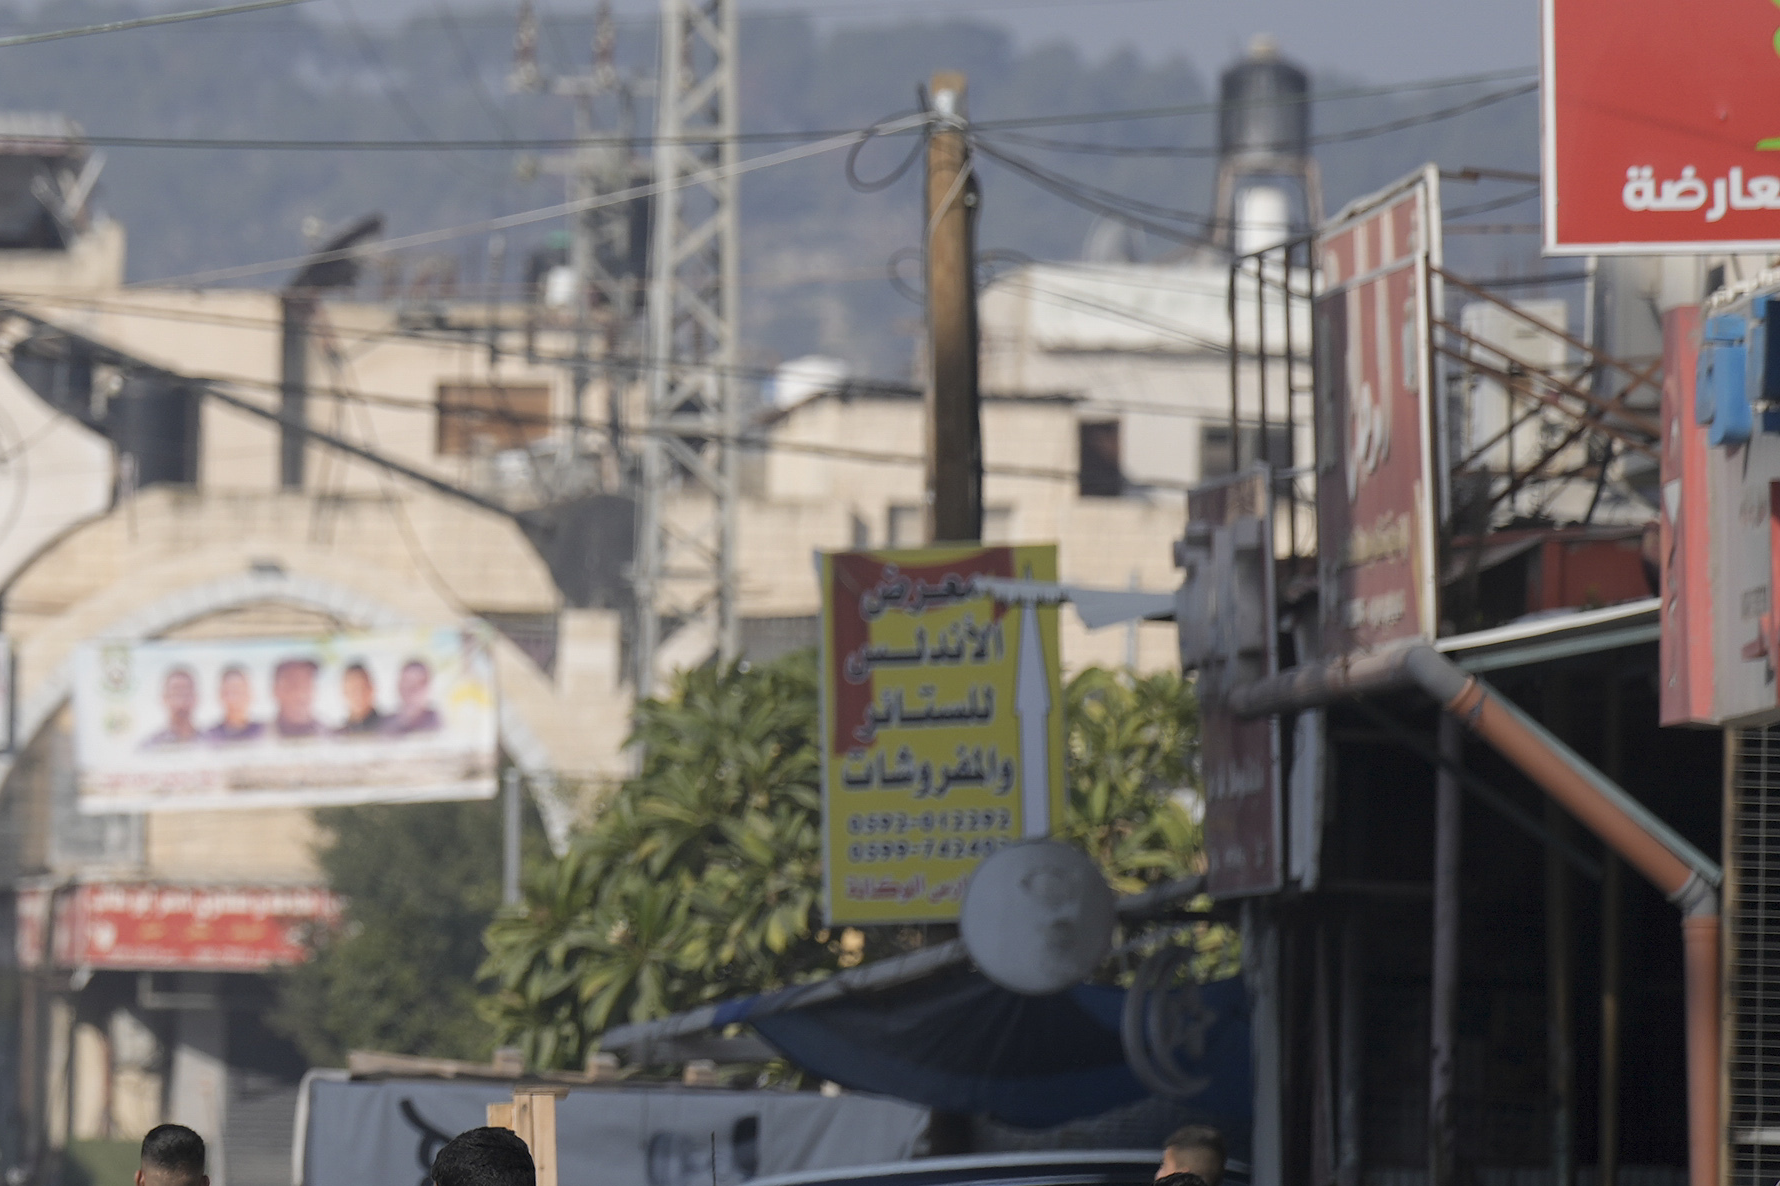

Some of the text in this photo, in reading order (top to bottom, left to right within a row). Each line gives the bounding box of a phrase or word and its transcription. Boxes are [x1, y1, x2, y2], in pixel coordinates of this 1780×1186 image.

[845, 612, 1004, 684] الأندلس
[853, 684, 994, 743] للستائر
[843, 743, 1015, 800] والمفروشات
